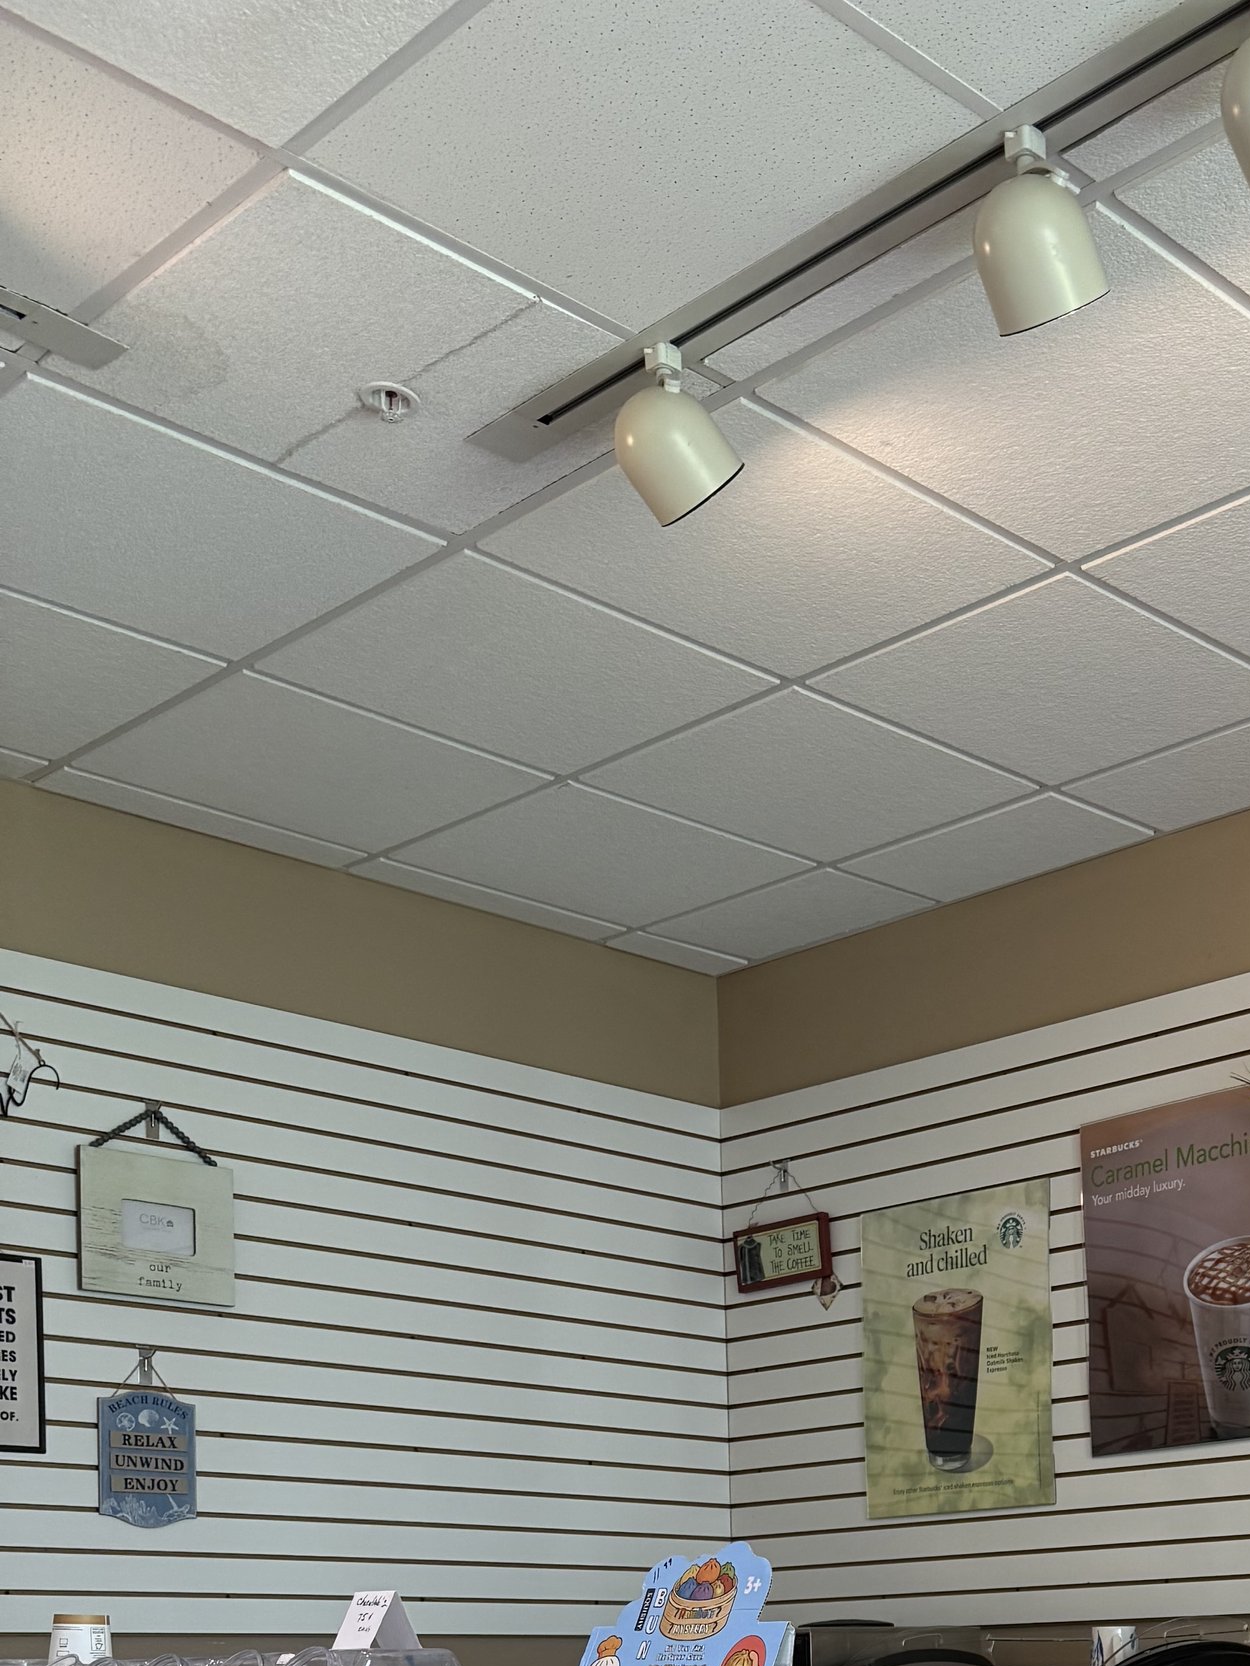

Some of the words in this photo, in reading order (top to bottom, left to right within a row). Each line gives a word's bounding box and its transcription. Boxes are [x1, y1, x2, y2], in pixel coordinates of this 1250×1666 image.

[1090, 1148, 1169, 1189] Caramel
[1091, 1192, 1113, 1207] Your
[1115, 1179, 1151, 1202] midday
[1152, 1177, 1186, 1194] luxury.
[791, 1229, 812, 1241] TIME
[919, 1225, 974, 1250] Shaken
[787, 1241, 814, 1256] SMELL
[149, 1263, 172, 1274] our
[770, 1260, 786, 1274] THE
[786, 1255, 816, 1271] COFFEE
[906, 1254, 934, 1278] and
[936, 1244, 988, 1272] chilled
[138, 1276, 183, 1292] family
[107, 1395, 148, 1414] BEACH
[152, 1396, 189, 1420] RULES
[121, 1433, 179, 1449] RELAX
[114, 1454, 185, 1472] UNWIND
[123, 1477, 180, 1492] ENJOY
